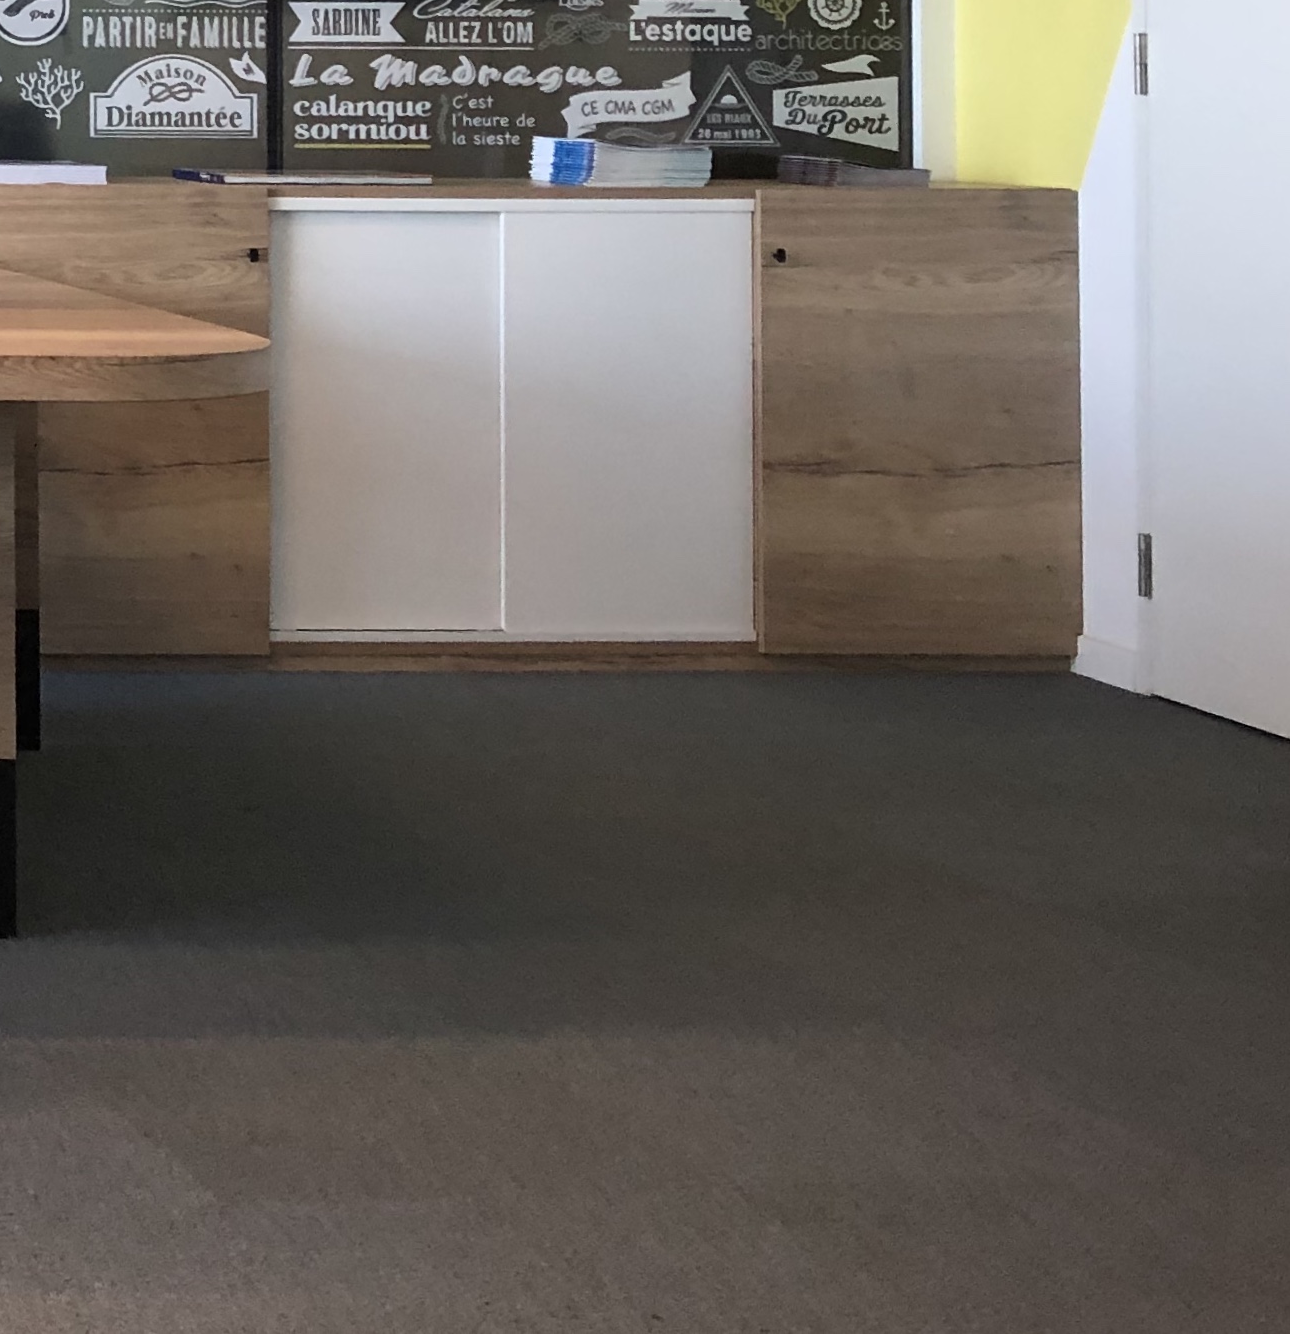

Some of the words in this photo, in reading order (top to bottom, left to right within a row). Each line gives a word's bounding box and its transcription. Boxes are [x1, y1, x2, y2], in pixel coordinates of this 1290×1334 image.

[311, 8, 382, 36] SARDINE
[293, 94, 432, 124] calanque
[581, 101, 597, 116] CE
[604, 100, 636, 115] CMA
[641, 98, 675, 115] CGM
[293, 118, 432, 141] sormiou
